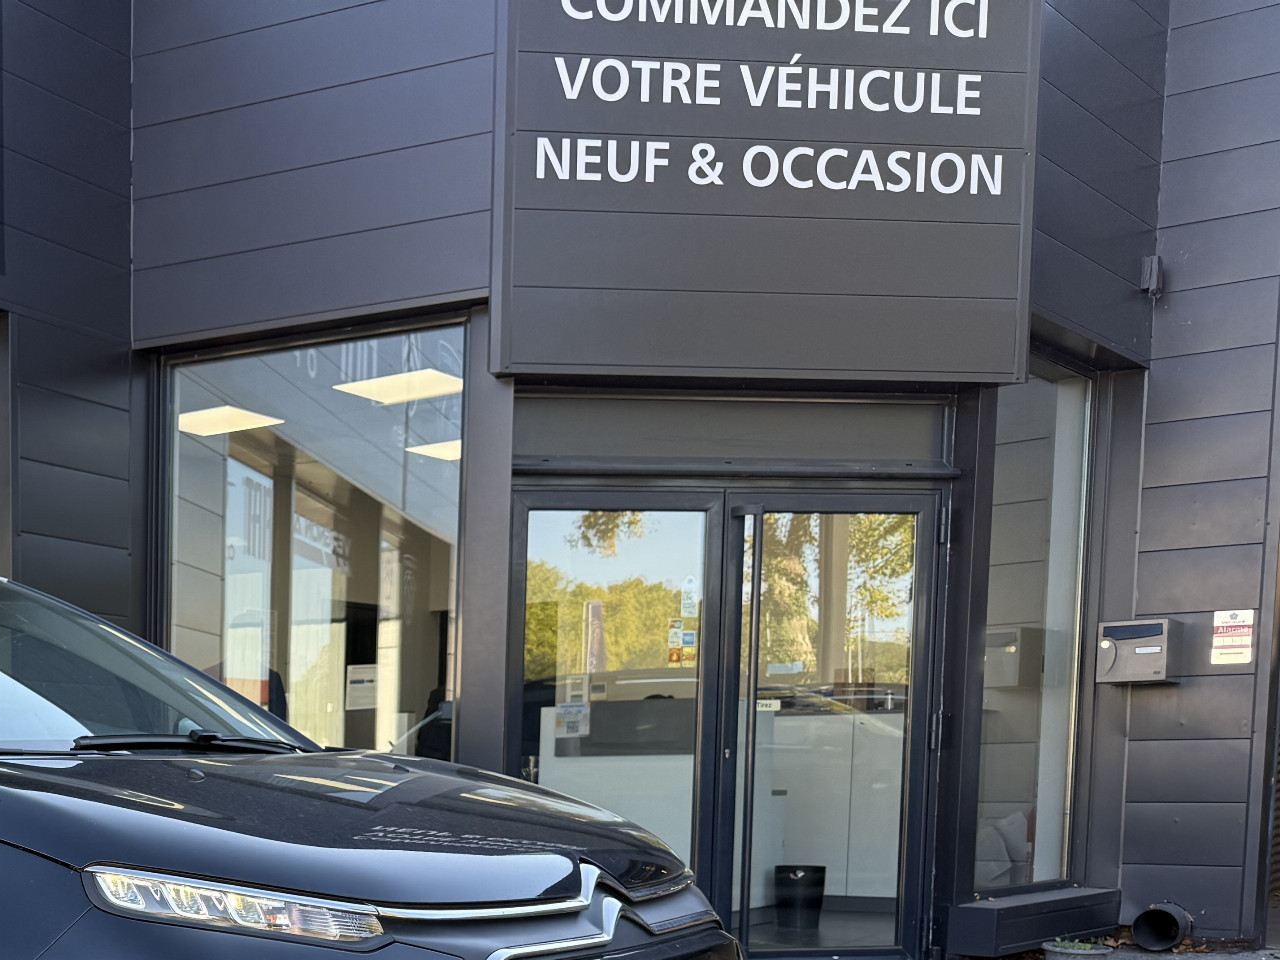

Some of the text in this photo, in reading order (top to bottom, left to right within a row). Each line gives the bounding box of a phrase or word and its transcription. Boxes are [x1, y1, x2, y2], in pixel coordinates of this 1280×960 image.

[929, 0, 989, 38] ICI
[554, 53, 982, 115] VOTRE VÉHICULE
[535, 136, 1003, 195] NEUF & OCCASION
